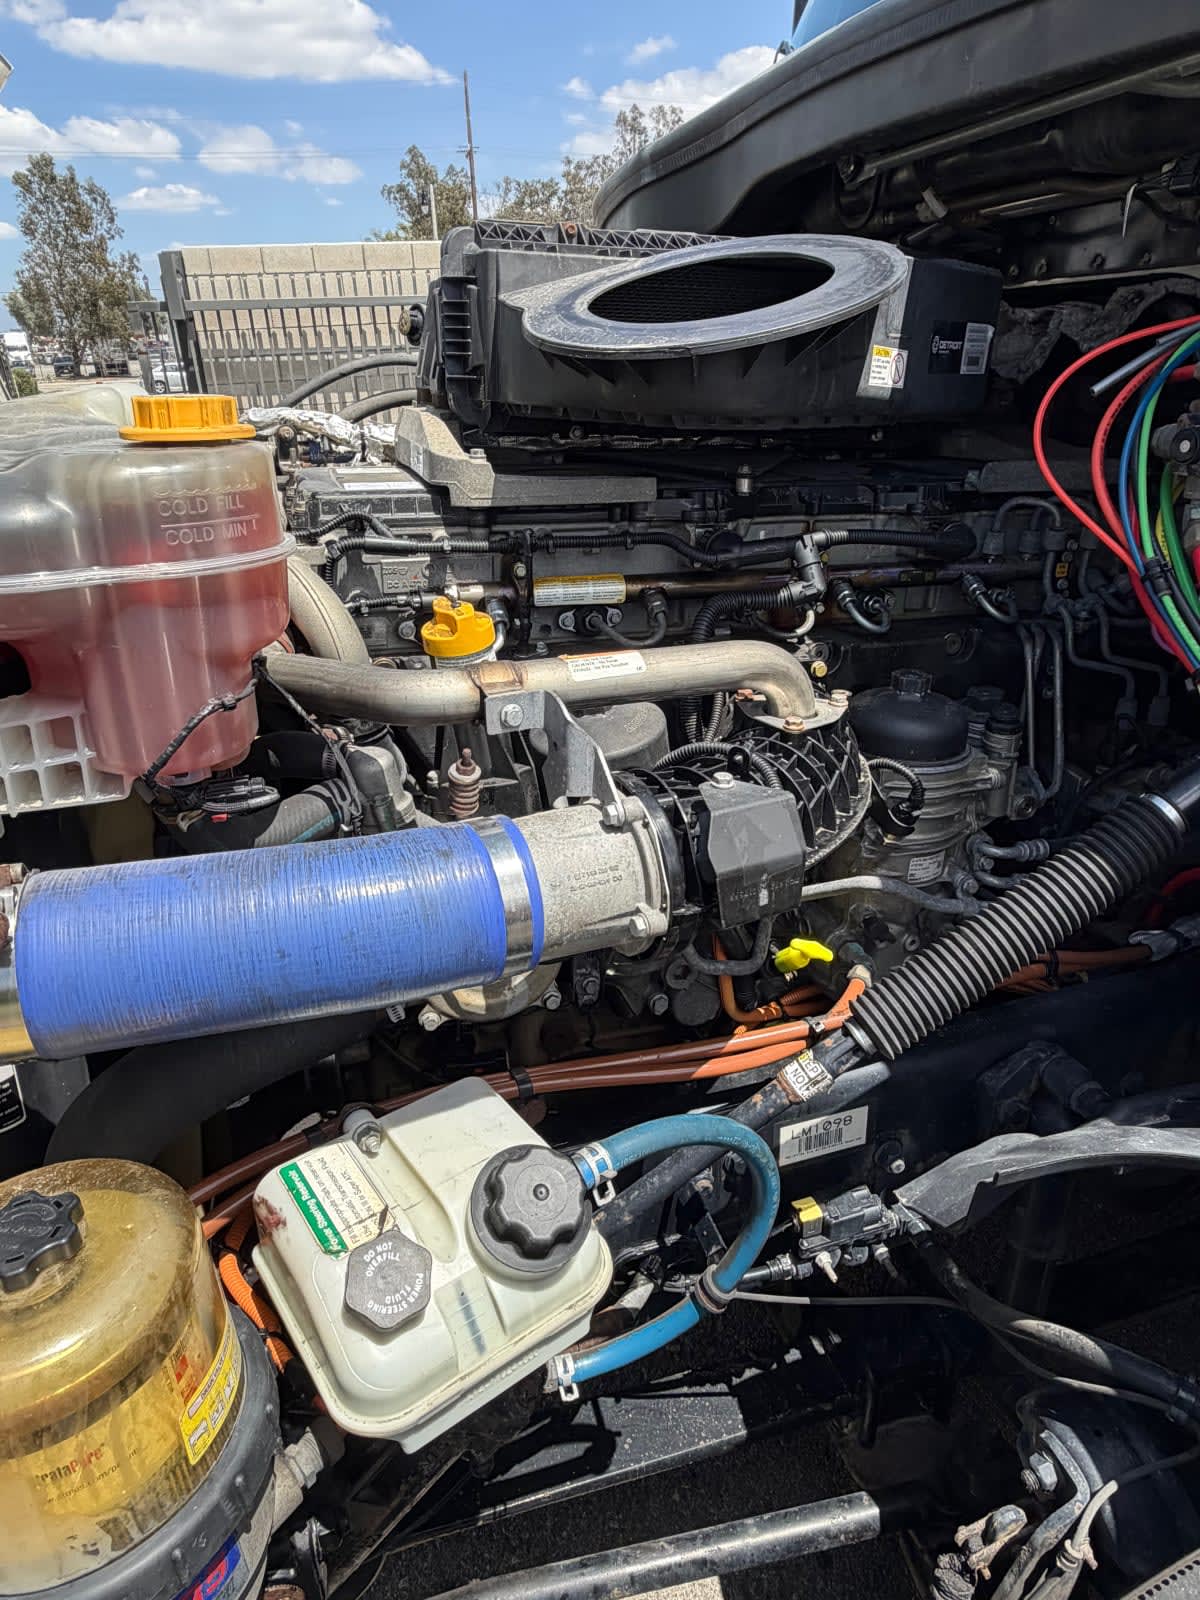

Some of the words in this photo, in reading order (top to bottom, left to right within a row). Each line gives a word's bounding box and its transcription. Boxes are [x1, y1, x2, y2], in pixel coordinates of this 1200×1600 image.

[939, 341, 962, 350] DETROIT
[159, 497, 208, 516] COLD
[216, 495, 245, 512] FILL
[165, 527, 215, 545] COLD
[222, 522, 247, 539] MIN
[317, 1157, 329, 1170] Fluid
[288, 1170, 310, 1201] Reservoir
[326, 1169, 348, 1201] Transmission
[306, 1199, 328, 1228] Steering
[363, 1250, 375, 1262] DO
[376, 1242, 393, 1252] NOT
[365, 1252, 400, 1277] OVERFILL
[385, 1284, 411, 1304] FLUID
[407, 1273, 424, 1303] POWER
[367, 1300, 408, 1315] STEERING
